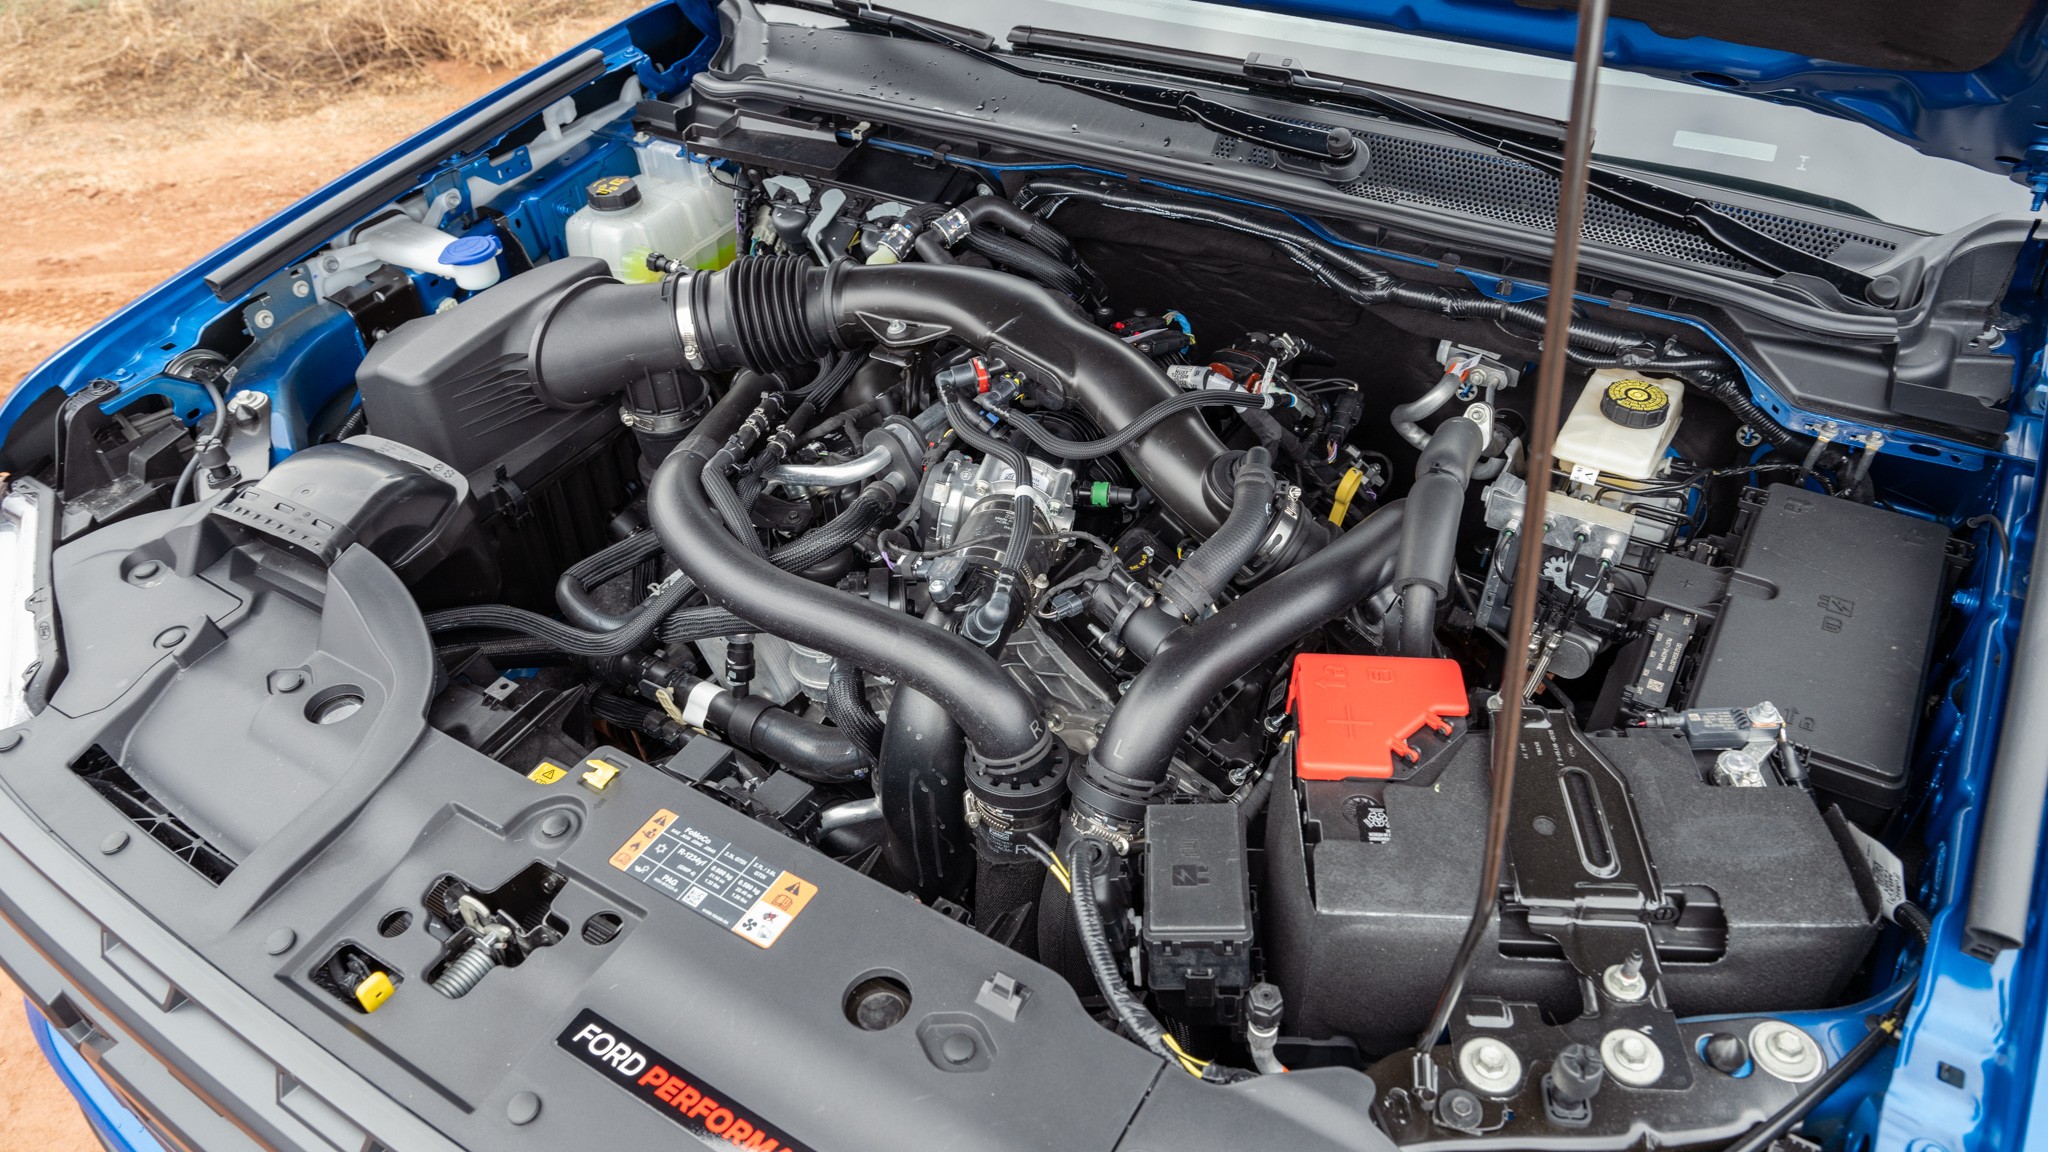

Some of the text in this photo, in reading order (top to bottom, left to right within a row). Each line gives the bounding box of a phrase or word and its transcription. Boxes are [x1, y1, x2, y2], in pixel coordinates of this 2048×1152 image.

[1029, 719, 1045, 740] R
[1112, 738, 1124, 760] L
[685, 827, 710, 845] FoMoCo
[678, 848, 707, 867] R-1234yf
[1015, 844, 1028, 855] R
[662, 874, 678, 886] PAG
[572, 1023, 647, 1077] FORD
